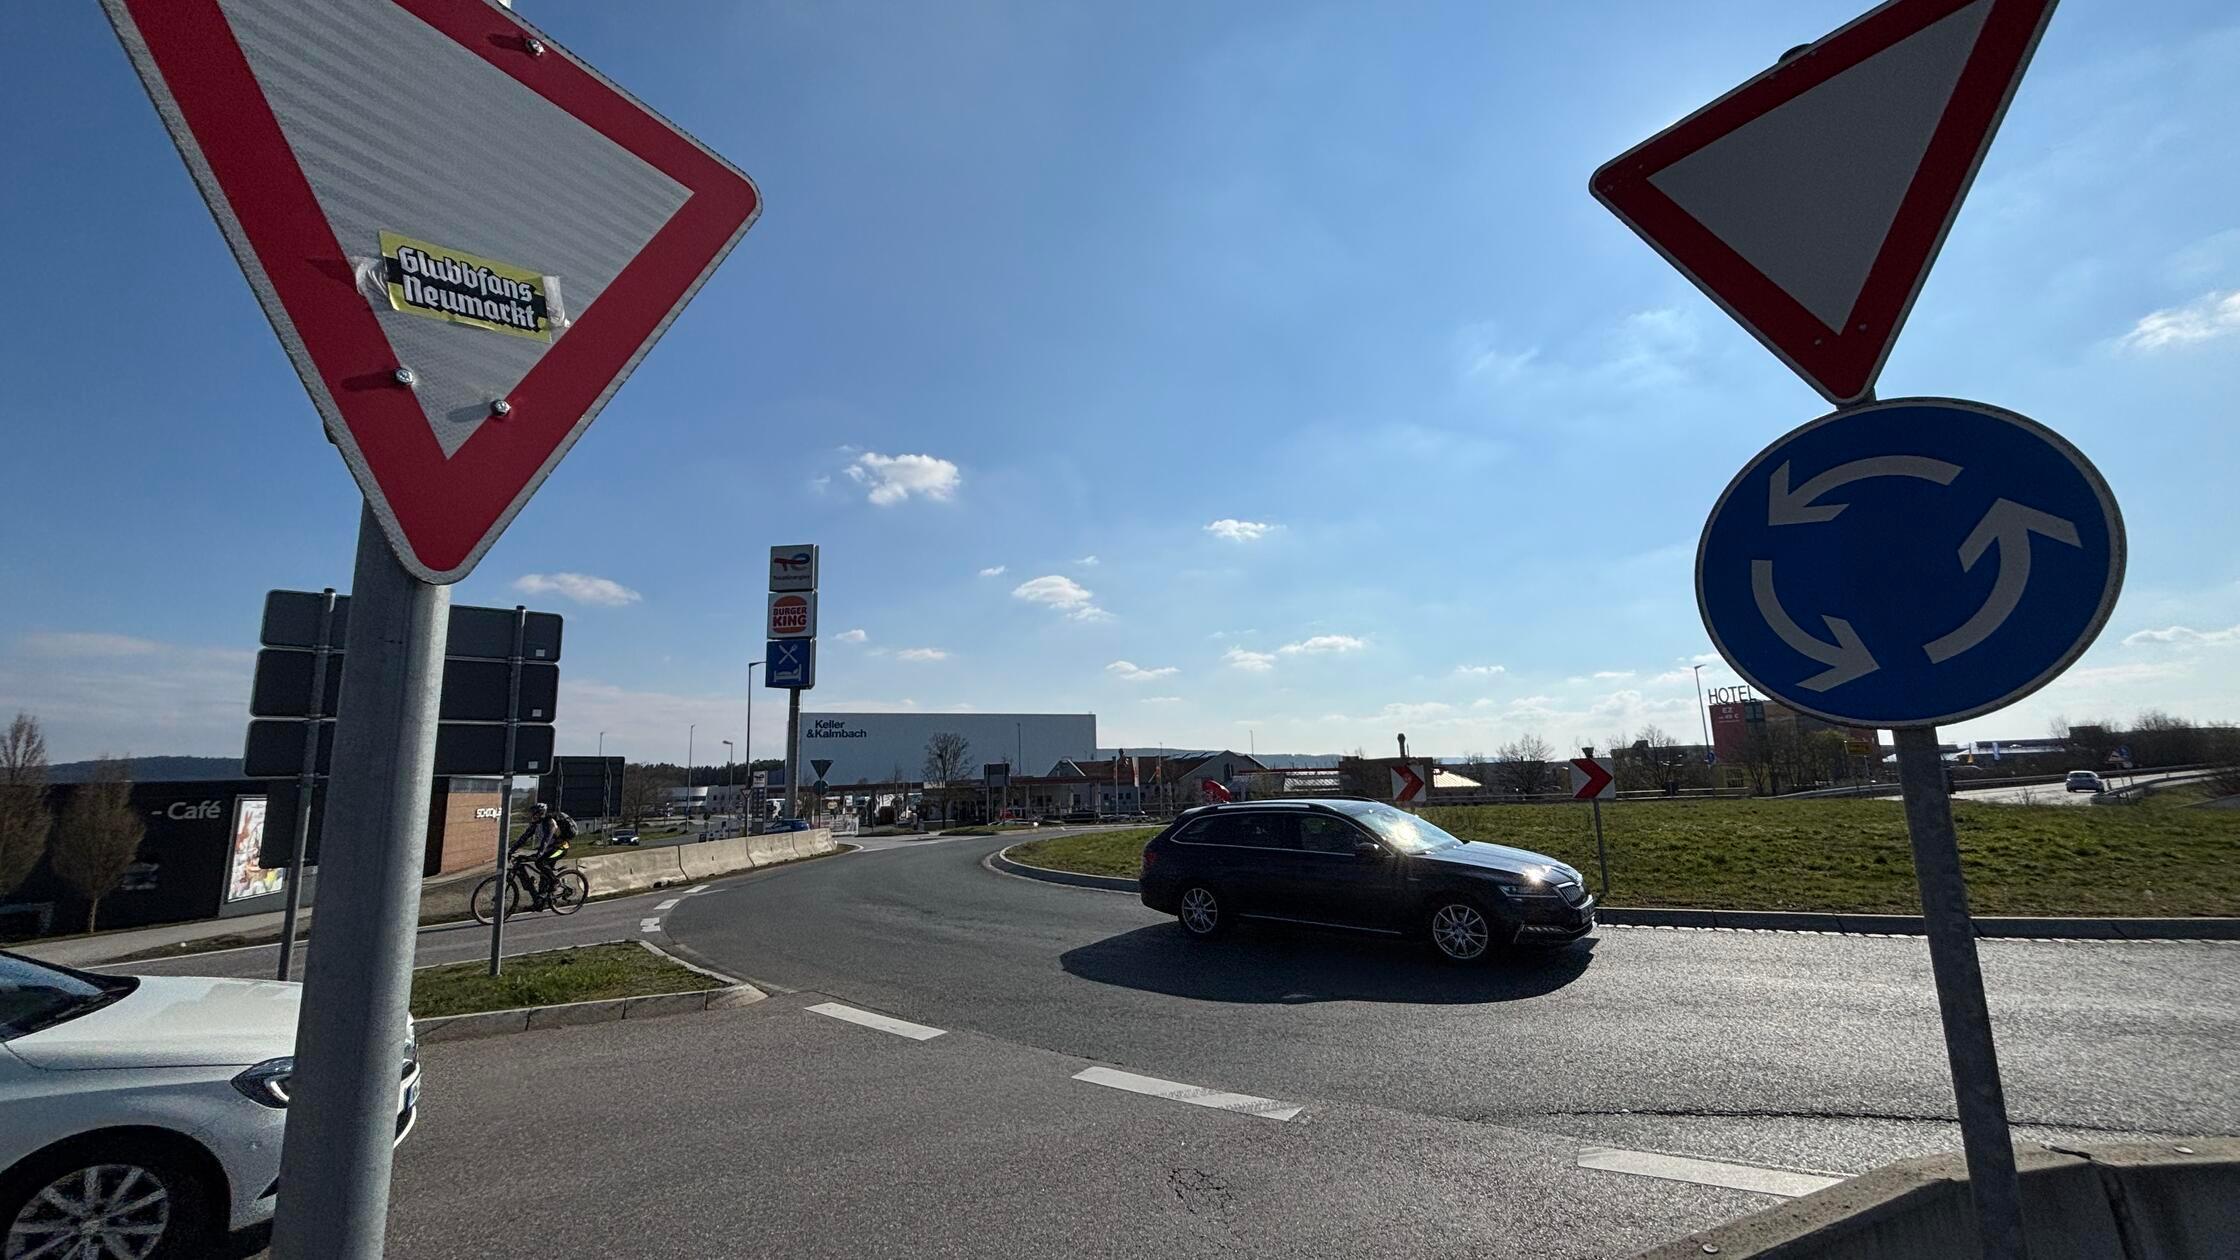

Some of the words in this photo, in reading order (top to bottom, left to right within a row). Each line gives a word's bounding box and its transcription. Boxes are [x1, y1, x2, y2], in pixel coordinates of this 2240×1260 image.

[398, 246, 533, 302] Glubbfans
[402, 274, 536, 328] Neumarkt
[773, 607, 807, 616] BURGER
[772, 615, 807, 627] KING
[1708, 685, 1756, 704] HOTEL
[815, 720, 845, 729] Keller
[806, 729, 867, 738] &Kalmbach
[167, 800, 221, 819] Café
